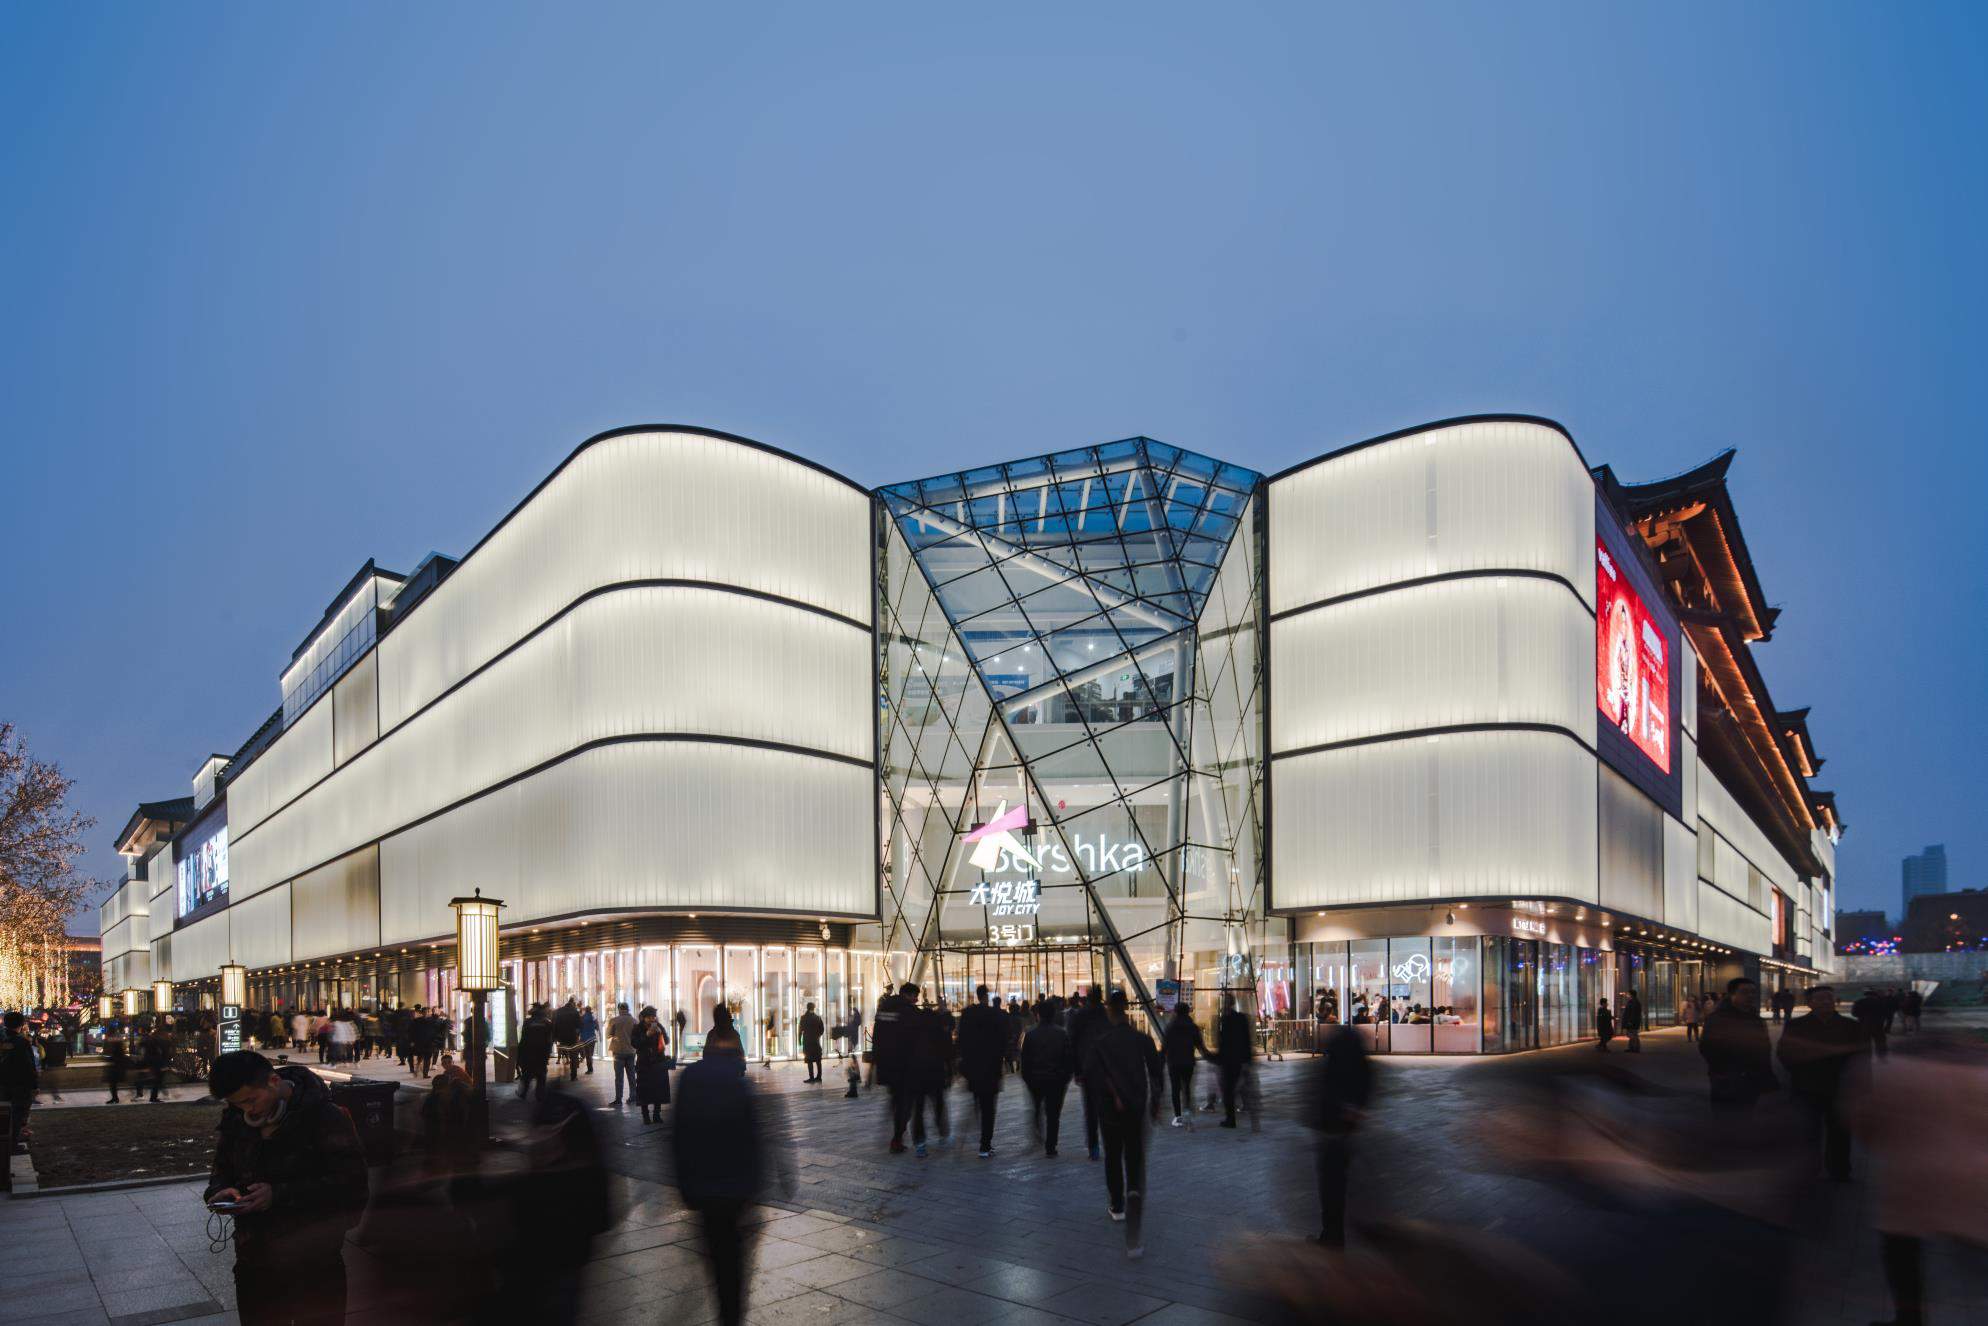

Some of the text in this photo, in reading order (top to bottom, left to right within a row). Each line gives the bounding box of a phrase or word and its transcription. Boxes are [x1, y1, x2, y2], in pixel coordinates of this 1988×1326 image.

[968, 880, 1037, 905] 大悦城
[992, 903, 1041, 916] JOY CITY
[989, 924, 1033, 942] 3号门
